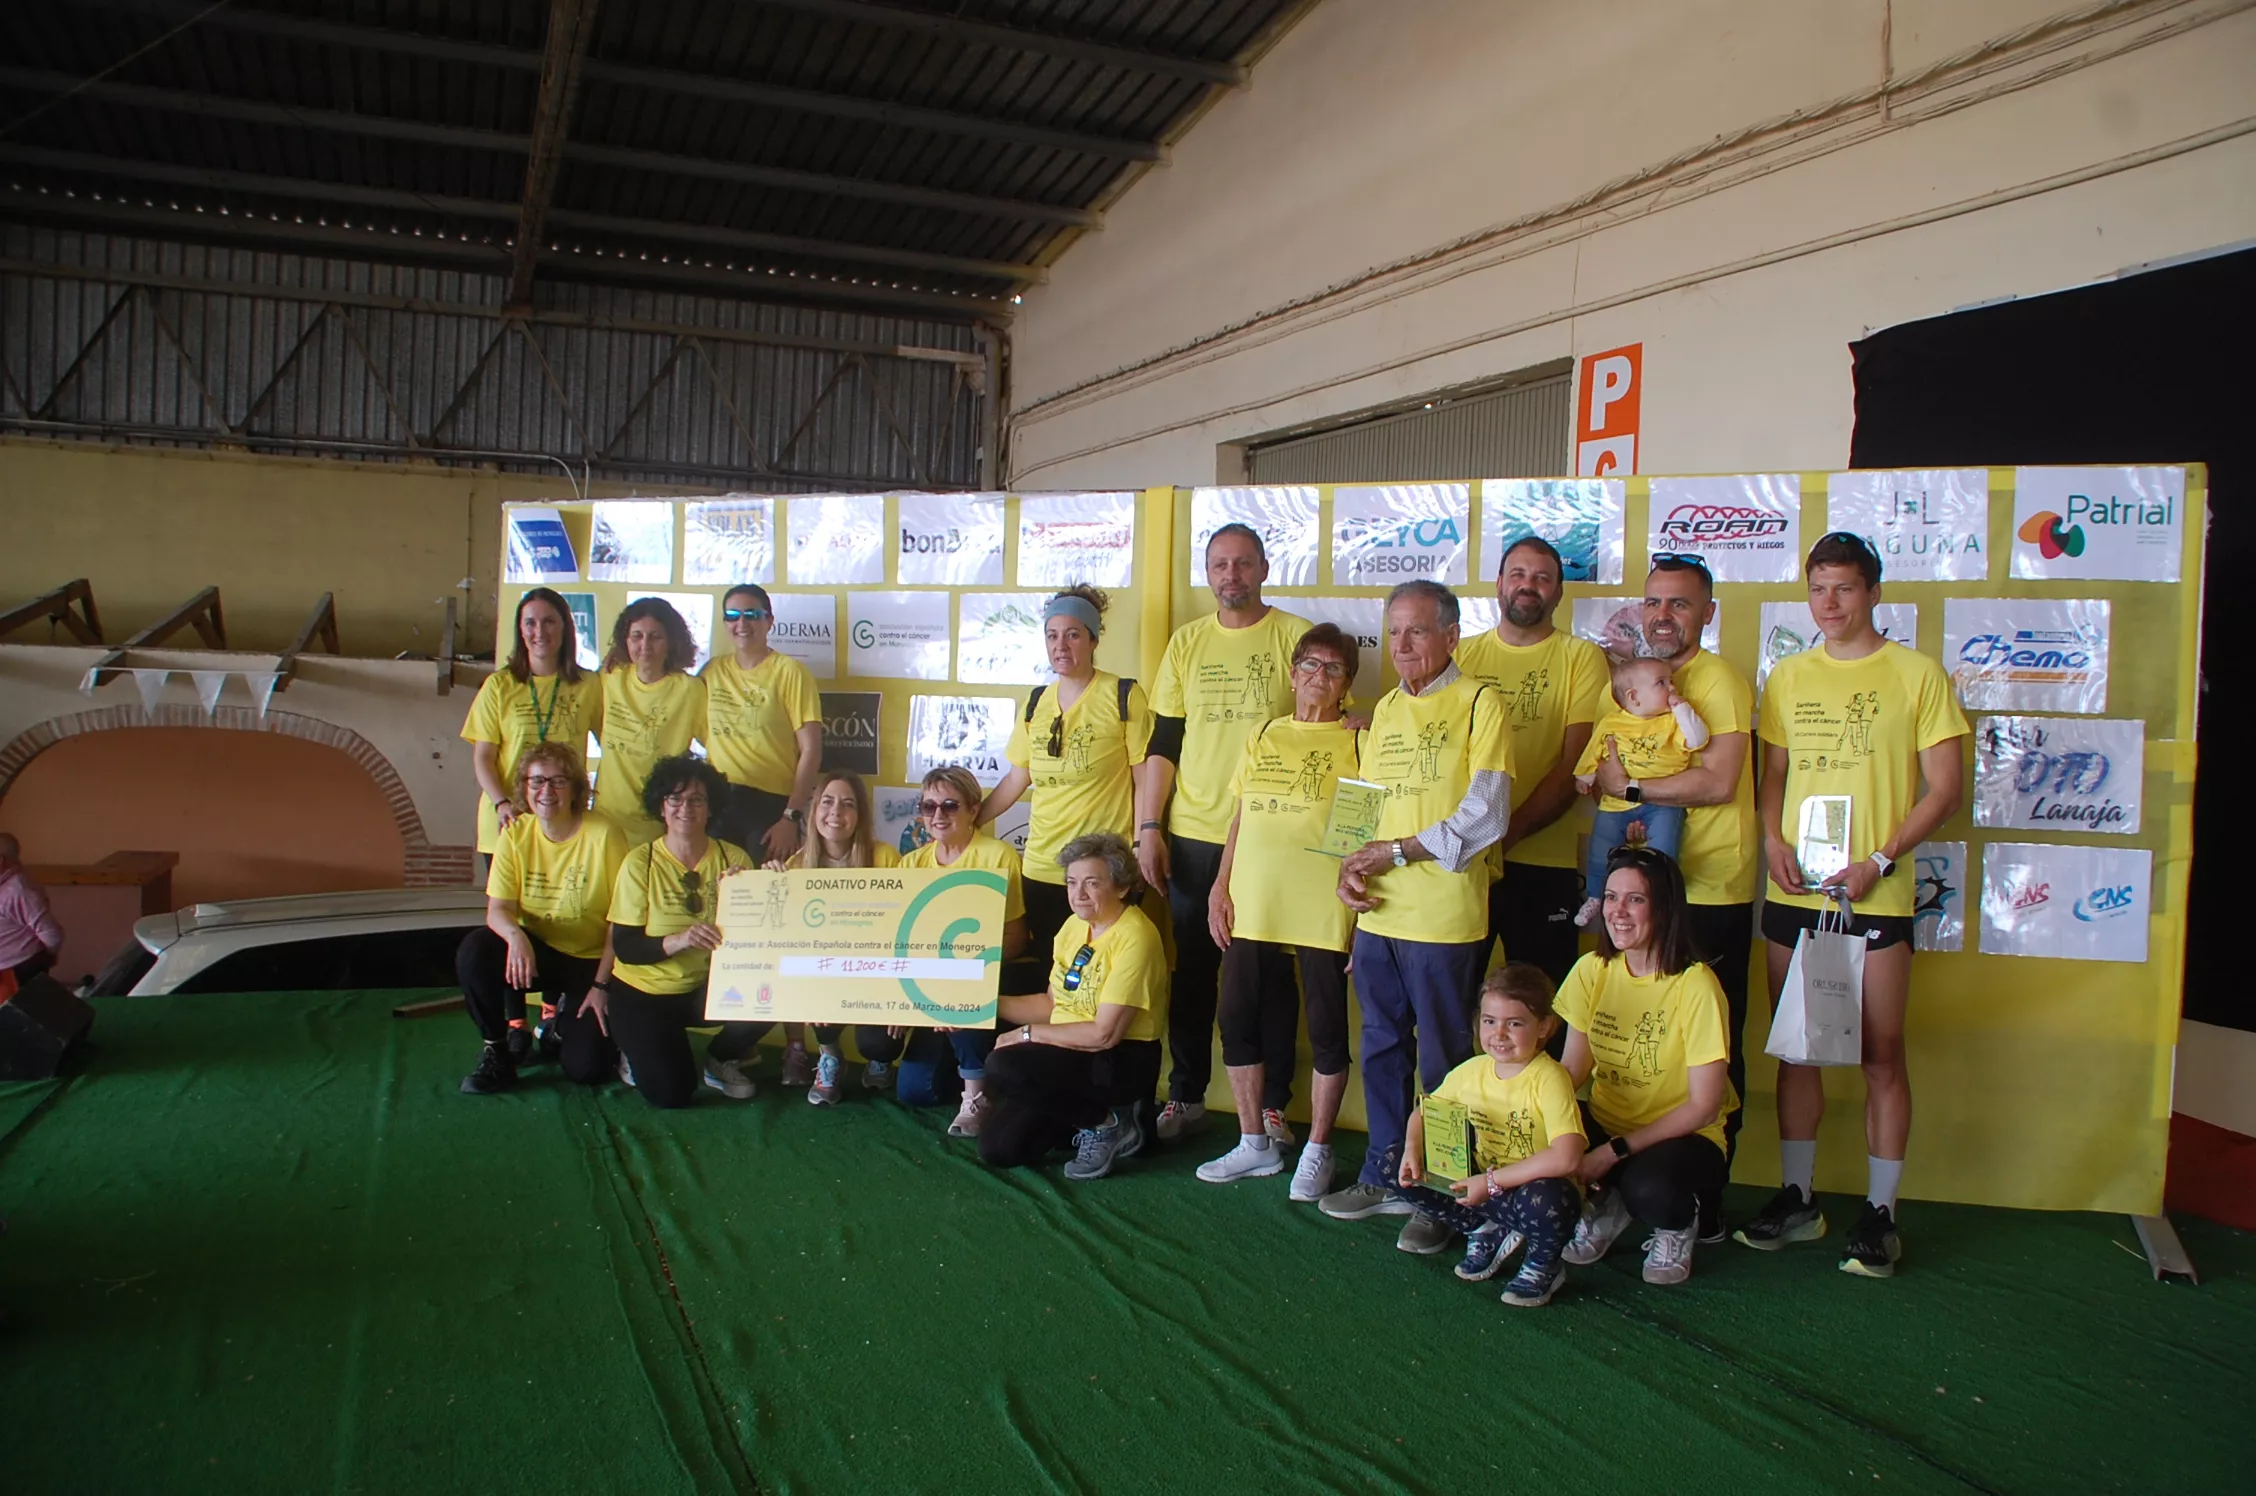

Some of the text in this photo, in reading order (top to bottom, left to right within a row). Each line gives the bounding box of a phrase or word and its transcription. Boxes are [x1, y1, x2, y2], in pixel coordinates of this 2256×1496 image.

[1589, 355, 1632, 432] P
[2066, 494, 2173, 525] Patrial
[1660, 518, 1789, 534] ROAN
[1703, 542, 1747, 550] PROYECTOS
[2029, 796, 2127, 829] Lanaja
[805, 879, 904, 890] DONATIVO PARA
[766, 940, 811, 949] Asociación
[813, 940, 852, 950] Española
[854, 942, 882, 950] contra
[883, 941, 892, 950] el
[894, 942, 925, 950] cáncer
[940, 942, 986, 952] Monegros
[841, 1000, 981, 1012] Sariñena, 17 de Marzo de 2024
